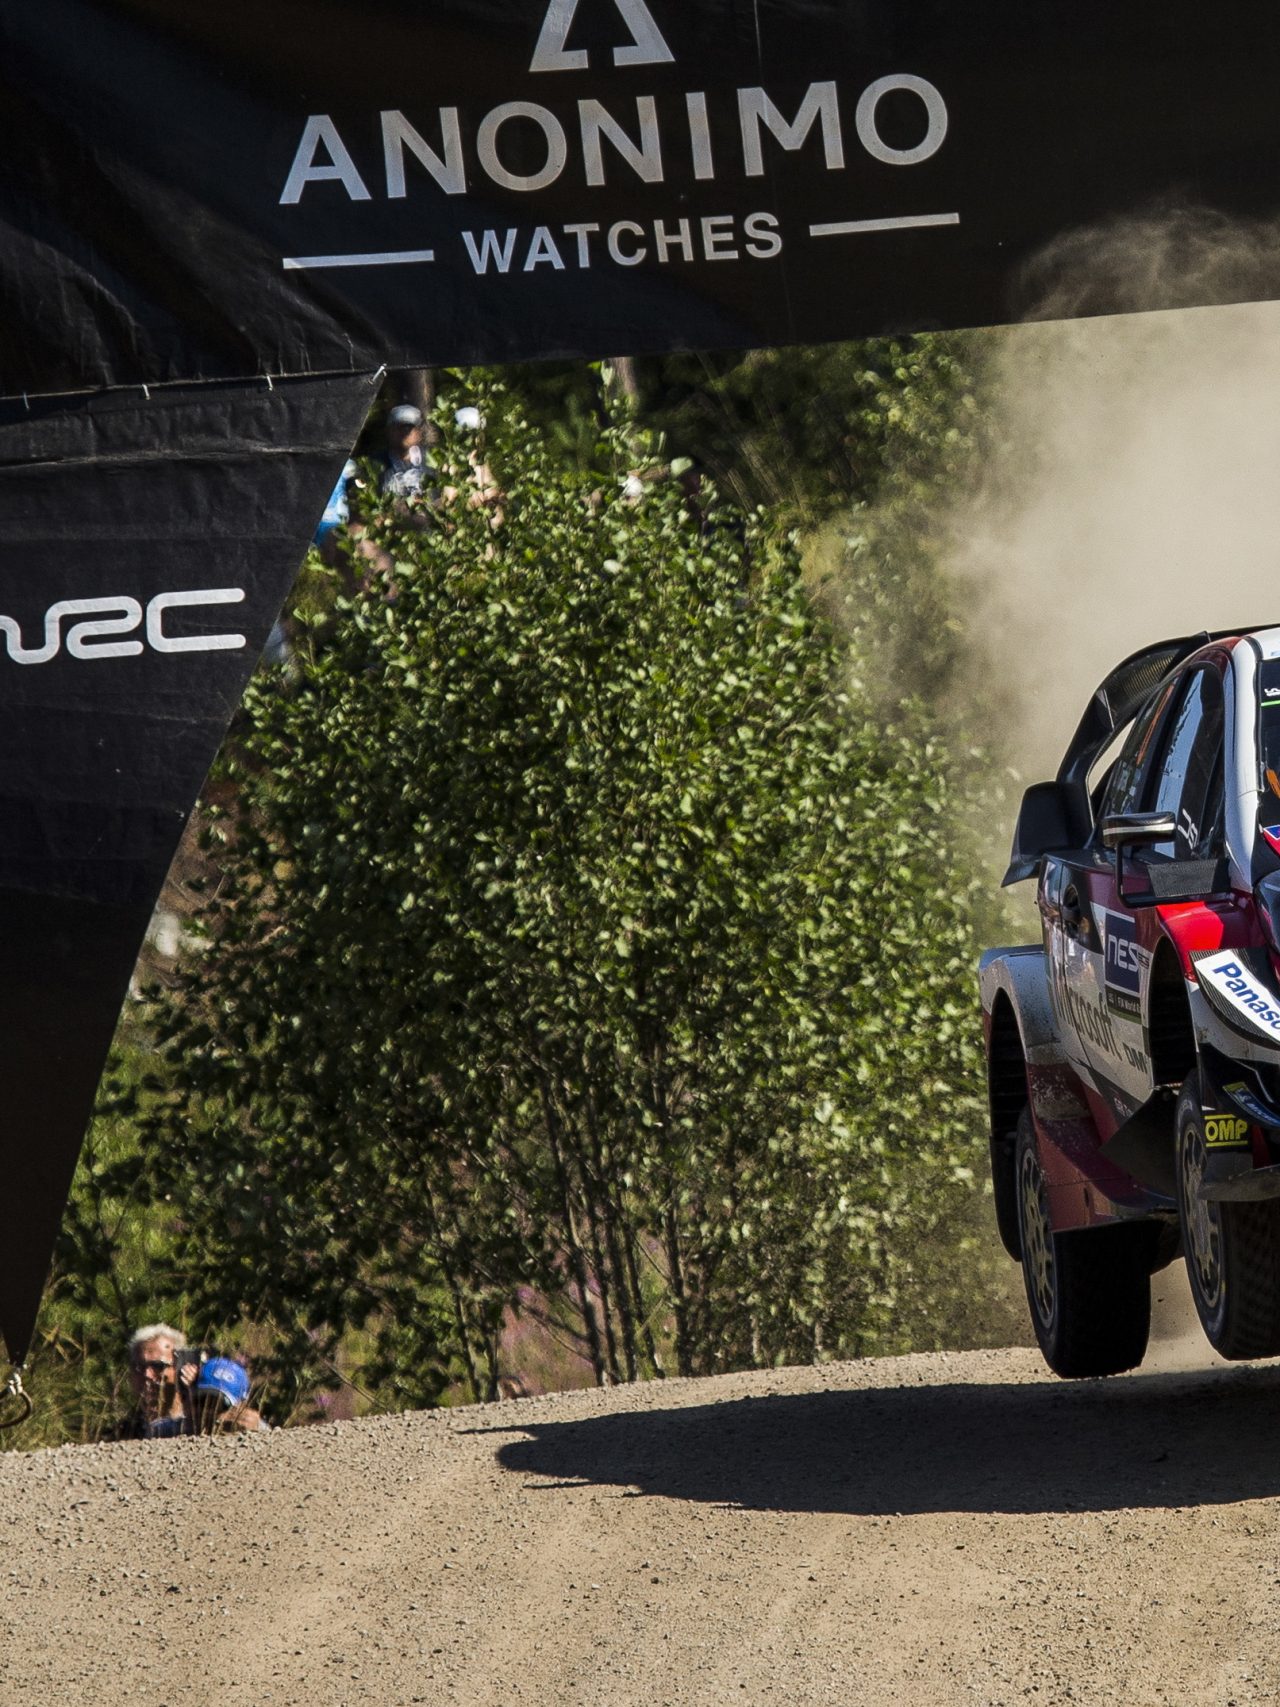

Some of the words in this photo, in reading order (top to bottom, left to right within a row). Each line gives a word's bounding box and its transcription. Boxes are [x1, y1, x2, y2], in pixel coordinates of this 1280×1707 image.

[279, 73, 949, 204] ANONIMO
[461, 211, 783, 275] WATCHES
[1205, 1119, 1248, 1141] OMP
